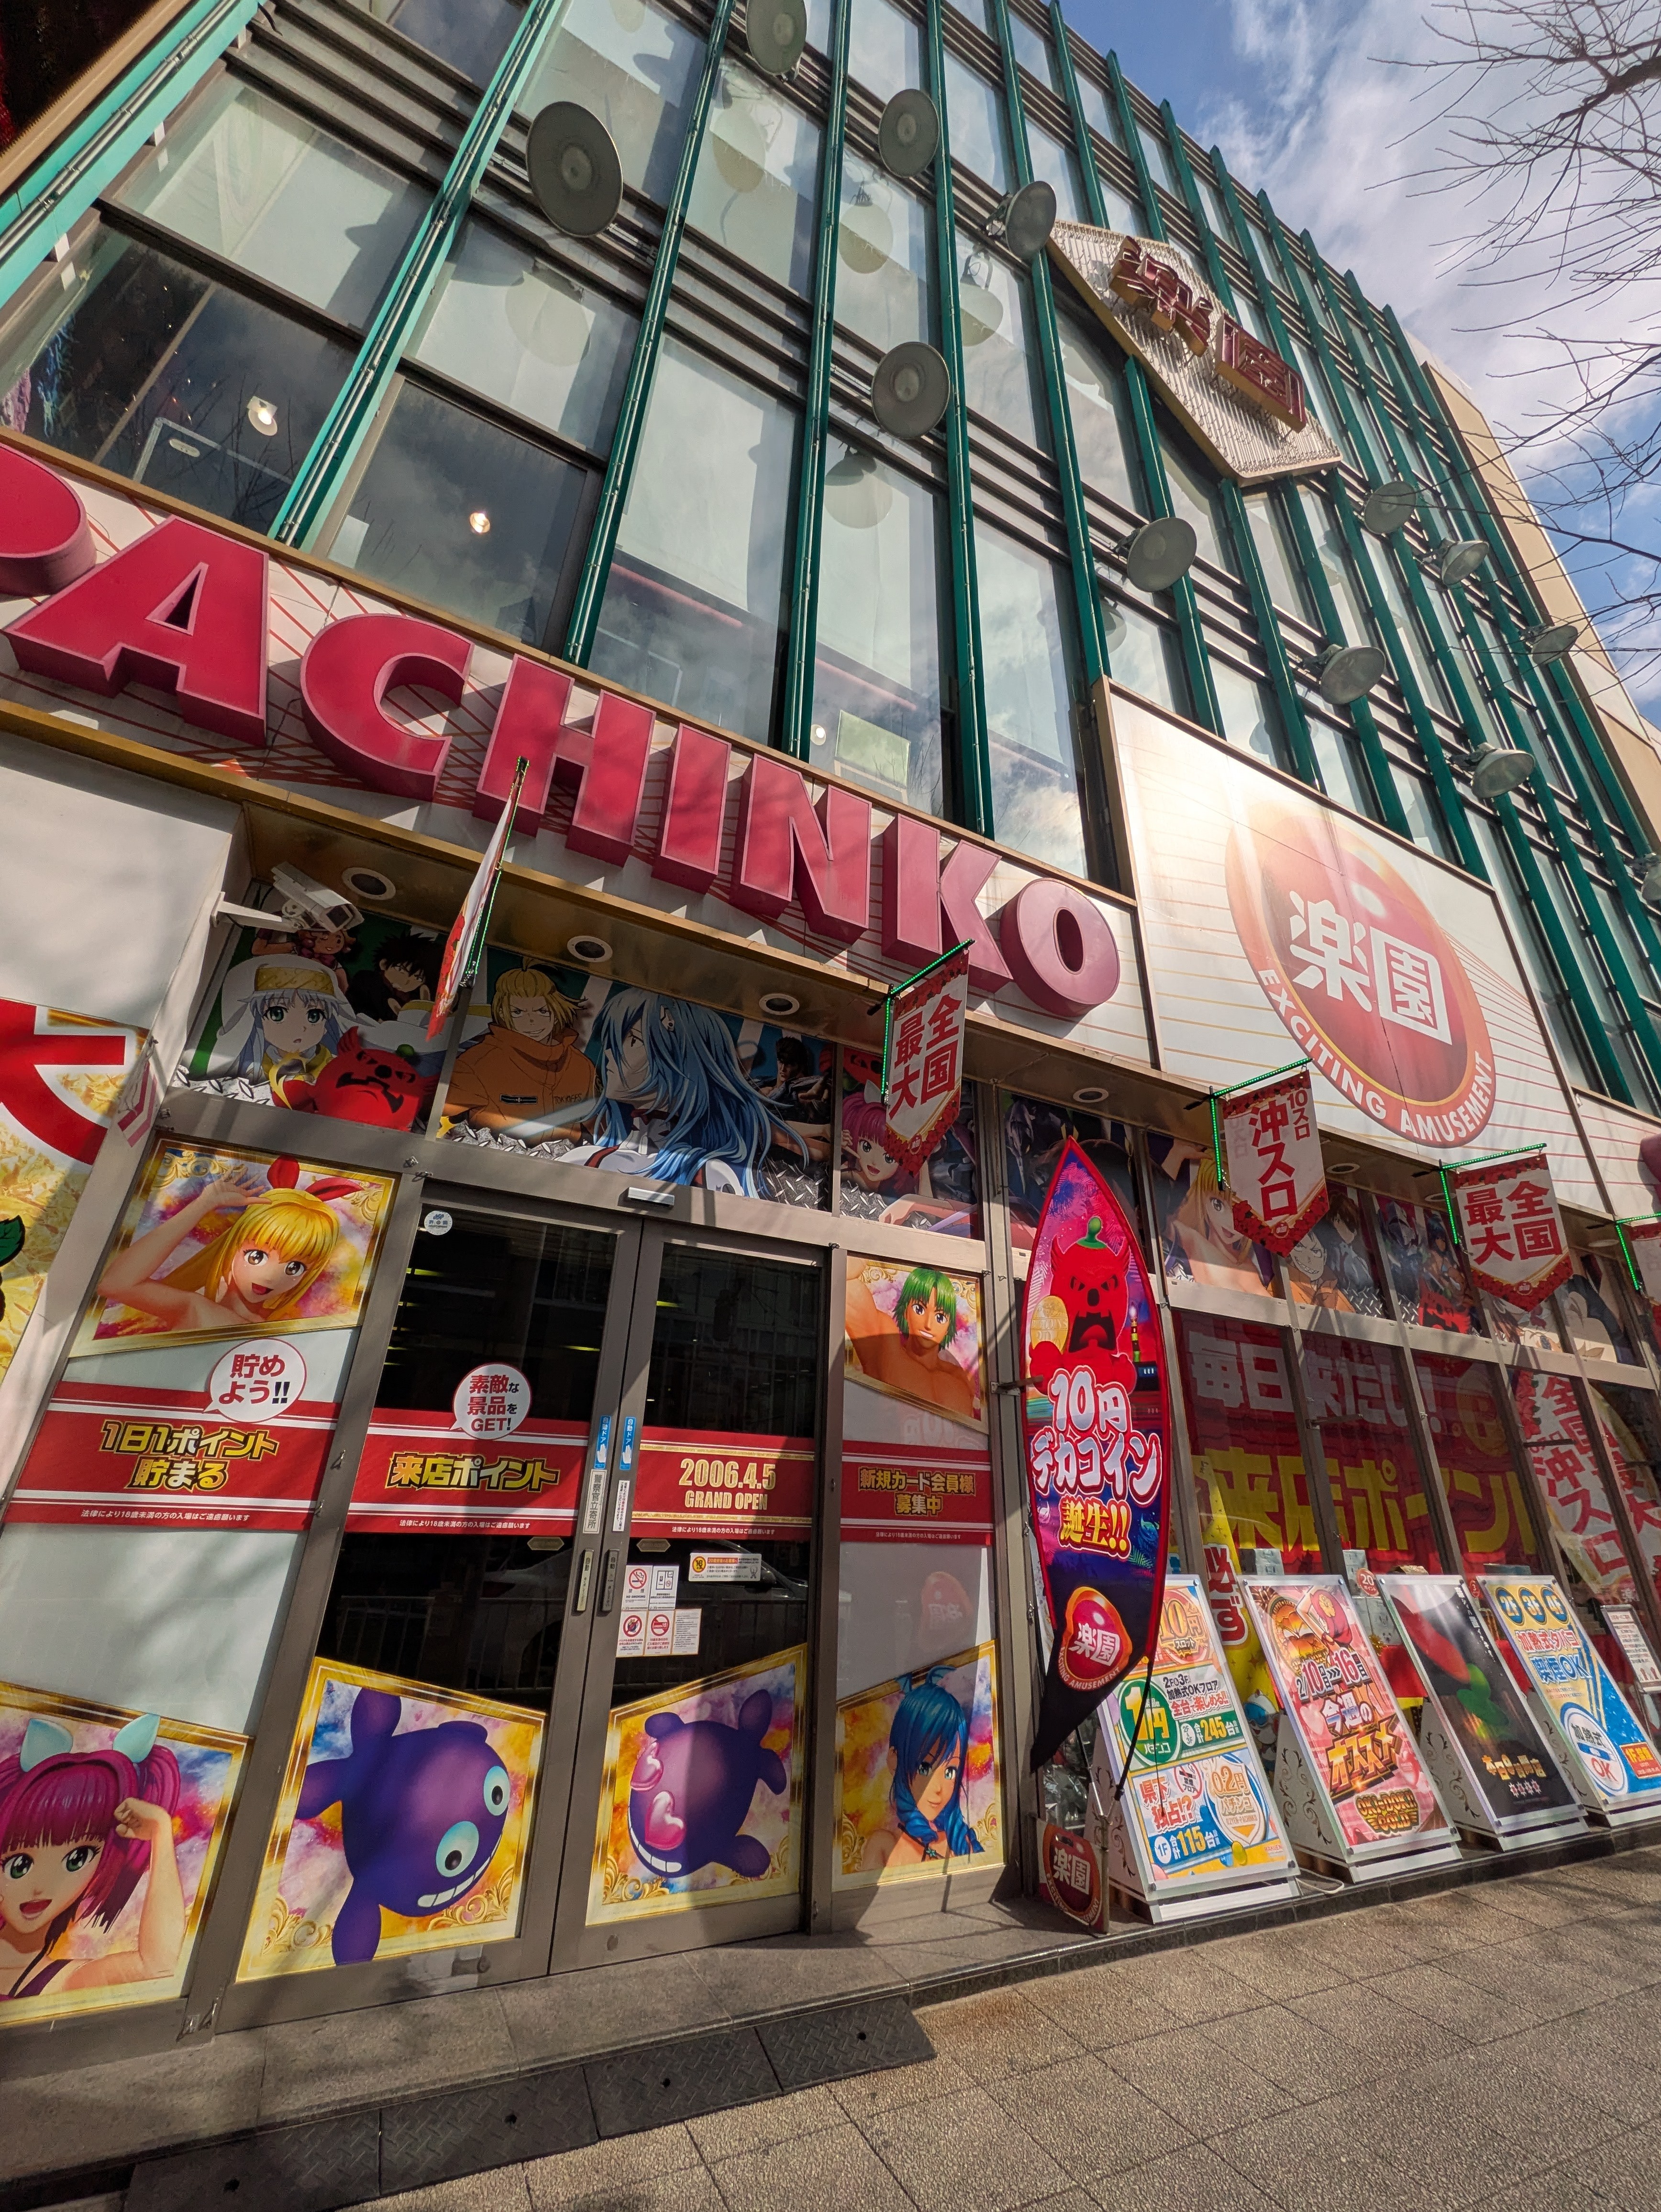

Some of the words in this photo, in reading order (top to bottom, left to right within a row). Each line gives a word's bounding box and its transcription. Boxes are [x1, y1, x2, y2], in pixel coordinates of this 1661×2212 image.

[1290, 890, 1452, 1045] 楽園
[921, 994, 963, 1105] 全国
[1257, 969, 1387, 1120] EXCITING
[1400, 1051, 1492, 1143] AMUSEMENT
[888, 1011, 925, 1120] 最大
[1286, 1089, 1310, 1143] 10スロ
[1248, 1100, 1298, 1222] 沖スロ
[1464, 1190, 1515, 1265] 最大
[1507, 1180, 1563, 1261] 全国
[231, 1353, 286, 1378] 貯め
[219, 1380, 289, 1405] よう!!
[469, 1375, 520, 1394] 素敵な
[467, 1396, 518, 1416] 景品を
[1052, 1367, 1128, 1434] 10円
[100, 1420, 279, 1460] 1日1ポイント
[471, 1418, 512, 1432] GET!
[600, 1417, 609, 1443] 自動ドア
[625, 1418, 633, 1444] 自動ドア
[125, 1457, 229, 1493] 貯まる
[385, 1451, 560, 1493] 来店ポイント
[679, 1459, 775, 1490] 2006.4.5
[1032, 1431, 1158, 1498] デカコイン
[858, 1466, 976, 1495] 新規カード会員様
[81, 1508, 250, 1522] 法律により18歳未満の方の入場はご遠慮願います
[587, 1474, 603, 1528] 警察官立寄所
[685, 1491, 731, 1509] GRAND
[735, 1492, 767, 1510] OPEN
[894, 1491, 943, 1516] 募集中
[399, 1519, 530, 1529] 法律により18歳未満の方の入場はご遠慮願います
[1061, 1499, 1128, 1551] 誕生!!
[1360, 1573, 1374, 1586] 20
[1069, 1622, 1120, 1666] 楽園
[1175, 1639, 1196, 1649] スロット
[1516, 1629, 1581, 1652] 加熱式タバコ
[1057, 1647, 1070, 1682] EXCITING
[1069, 1667, 1120, 1690] AMUSEMENT
[1321, 1692, 1373, 1732] 今週の
[1571, 1723, 1606, 1748] 加熱式
[1327, 1719, 1395, 1787] オススメ
[1591, 1758, 1619, 1783] OK
[1141, 1776, 1169, 1804] 県下
[1221, 1797, 1254, 1815] パチンコ
[1157, 1840, 1168, 1857] 1F
[1053, 1847, 1091, 1895] 楽園
